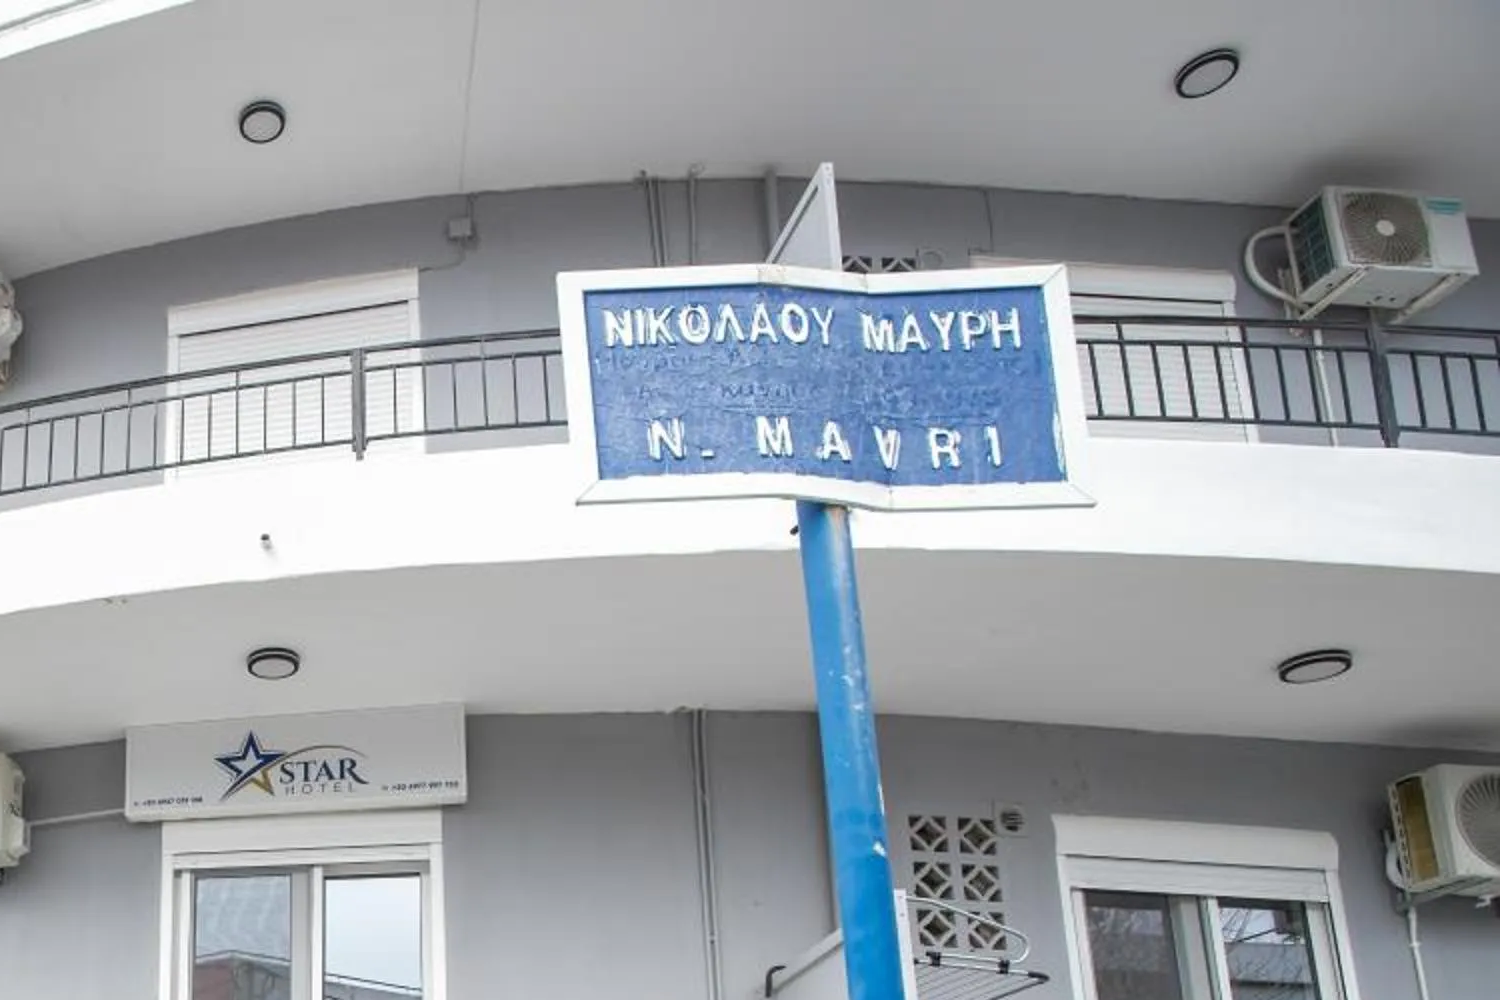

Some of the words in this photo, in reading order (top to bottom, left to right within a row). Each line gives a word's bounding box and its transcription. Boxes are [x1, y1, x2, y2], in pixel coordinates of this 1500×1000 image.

[603, 302, 835, 348] ΝΙΚΟΛΑΟΥ
[858, 307, 1023, 353] ΜΑΥΡΗ
[279, 757, 369, 785] STAR
[284, 781, 357, 796] HOTEL
